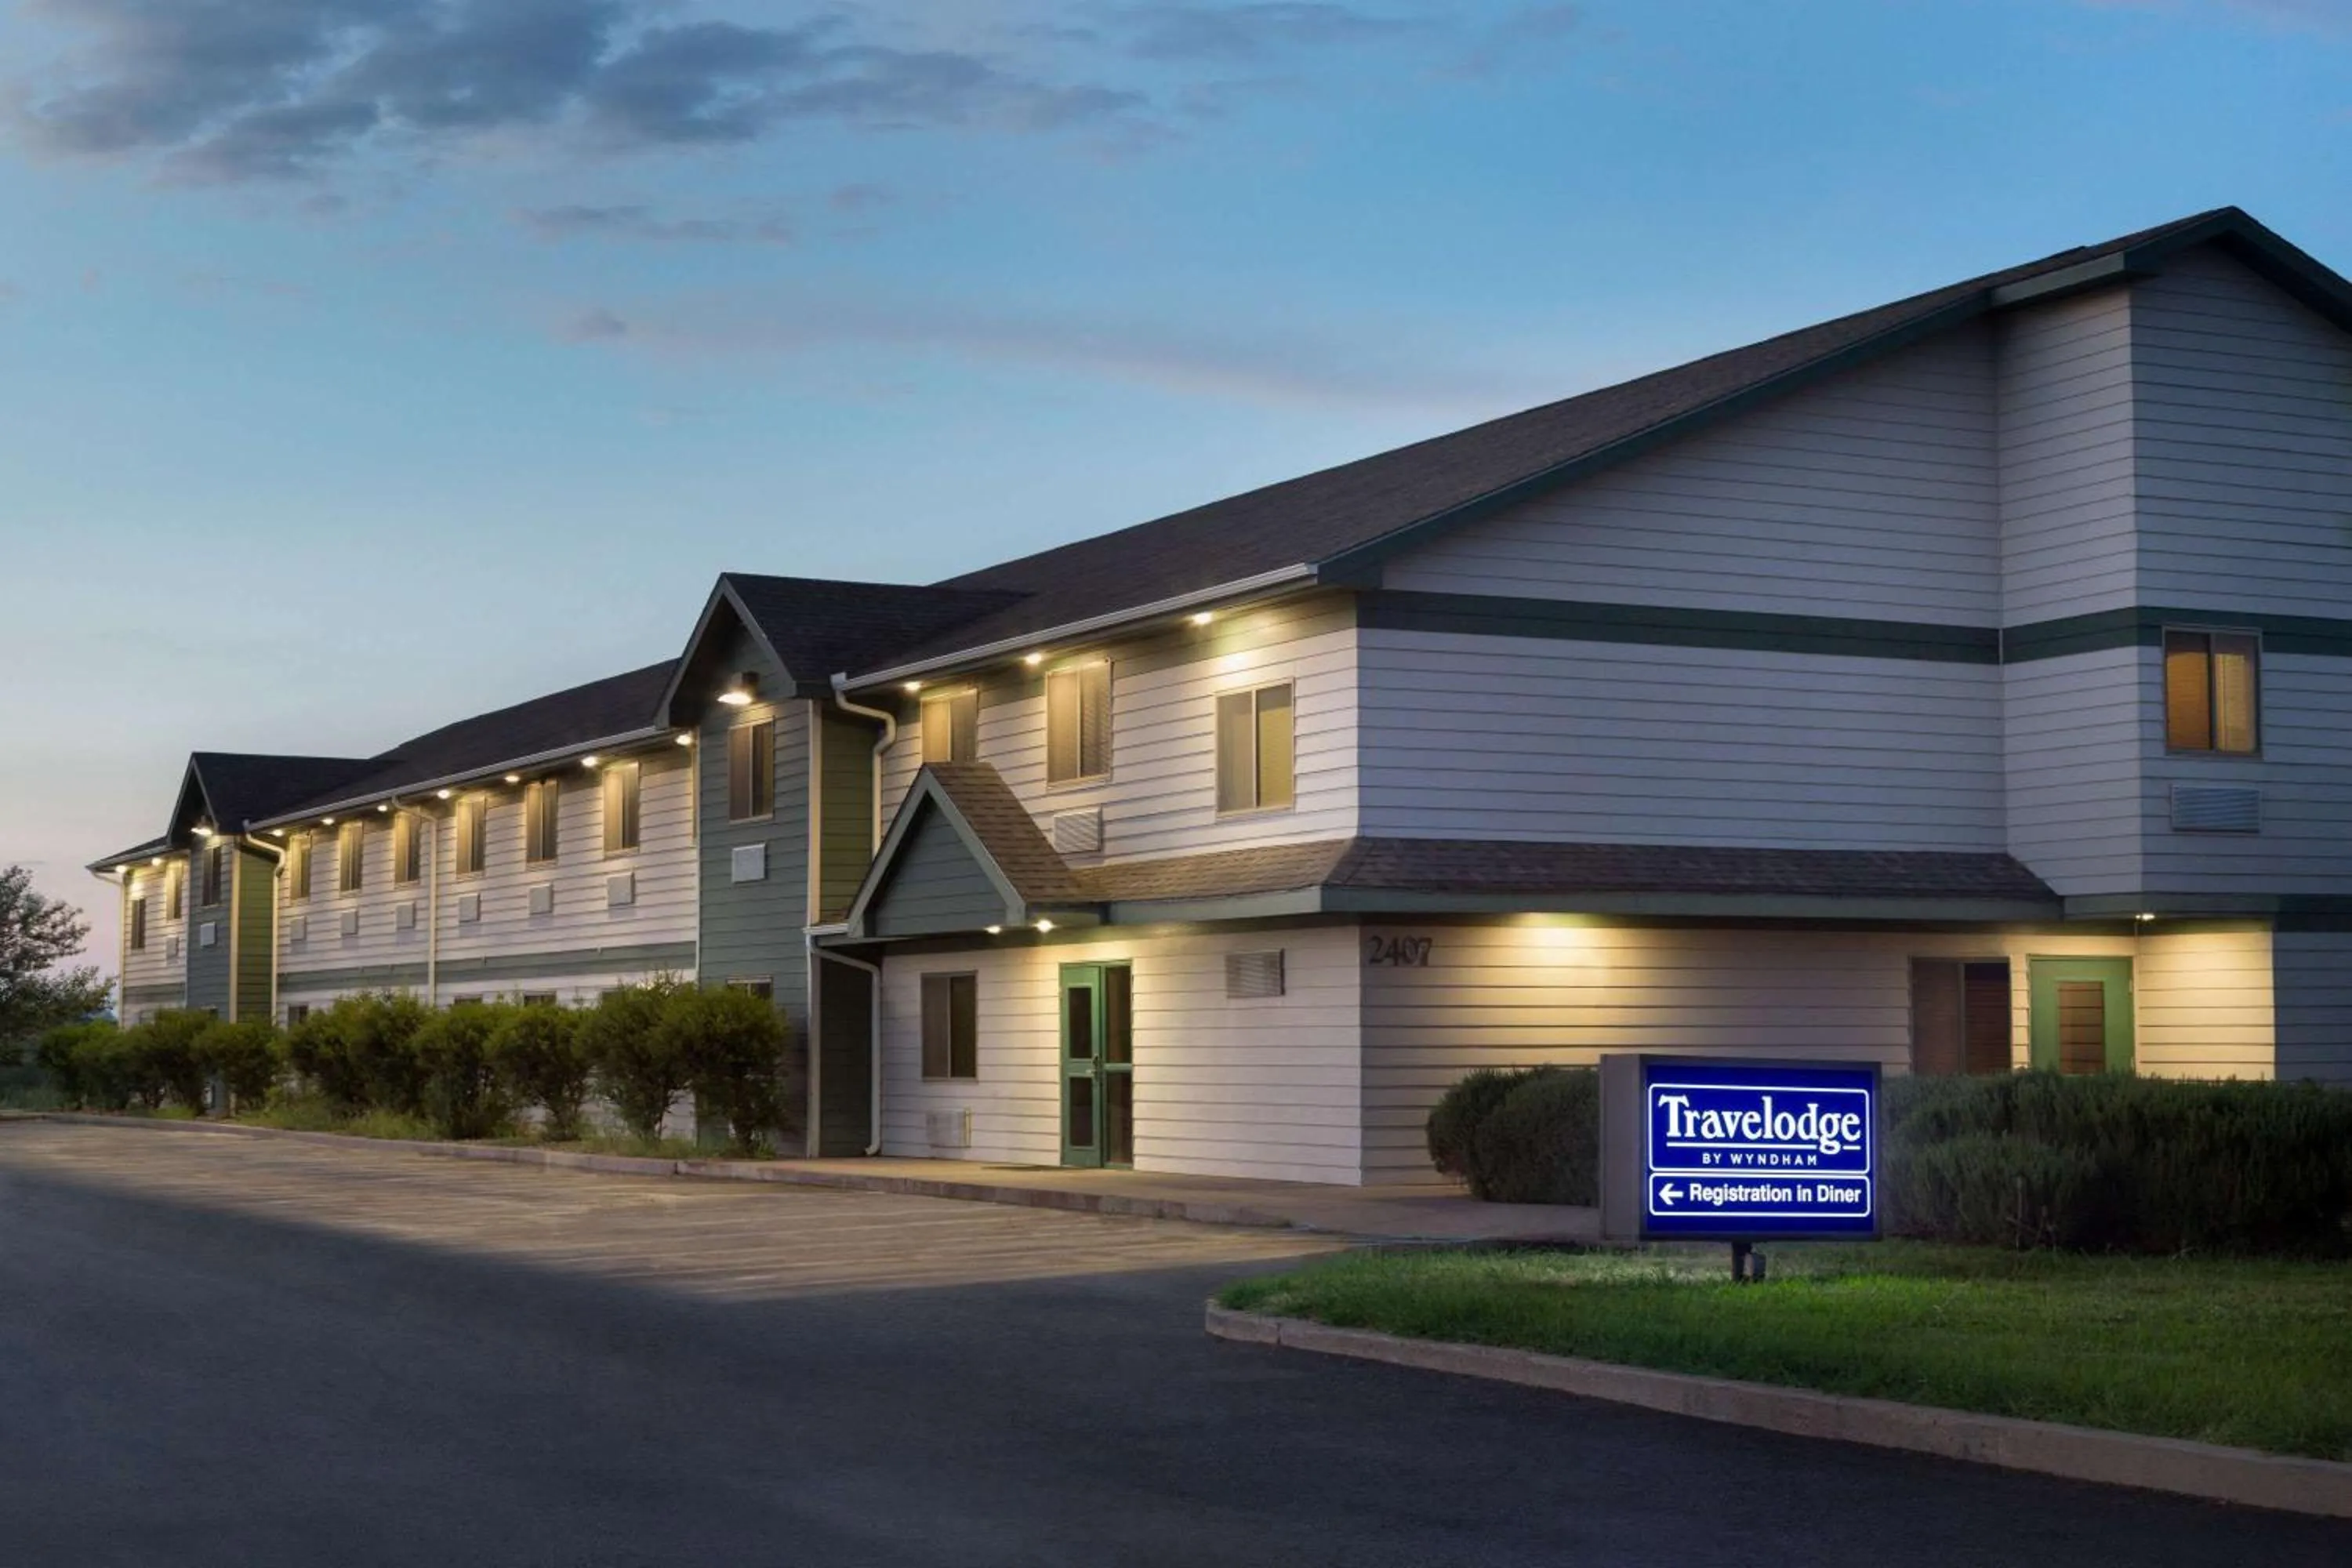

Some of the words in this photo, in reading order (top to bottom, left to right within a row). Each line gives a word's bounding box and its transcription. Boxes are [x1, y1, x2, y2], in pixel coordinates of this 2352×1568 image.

[1368, 935, 1433, 967] 2407
[1658, 1094, 1862, 1155] Travelodge
[1702, 1152, 1722, 1165] BY
[1730, 1153, 1818, 1166] WYNDHAM
[1689, 1183, 1793, 1207] Registration
[1796, 1184, 1813, 1203] in
[1817, 1185, 1862, 1203] Diner
